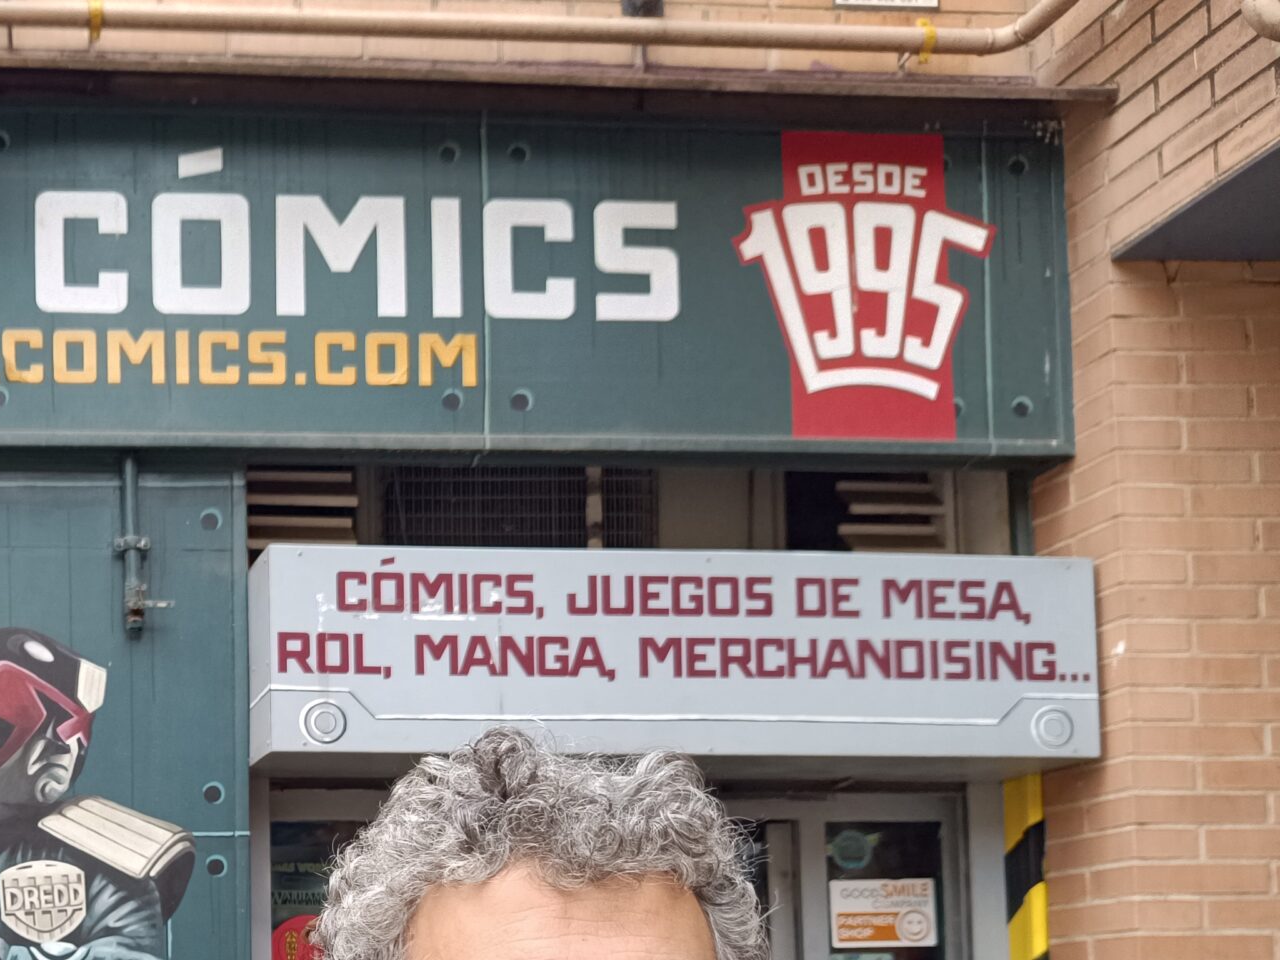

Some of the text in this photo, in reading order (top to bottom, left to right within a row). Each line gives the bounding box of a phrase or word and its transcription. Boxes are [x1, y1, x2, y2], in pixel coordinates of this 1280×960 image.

[797, 162, 928, 198] DESDE
[34, 147, 681, 322] CÓMICS
[739, 200, 990, 400] 1995
[336, 557, 1031, 625] CÓMICS, JUEGOS DE MESA,
[277, 632, 1091, 683] ROL, MANGA, MERCHANDISING...
[4, 882, 85, 911] DREDD
